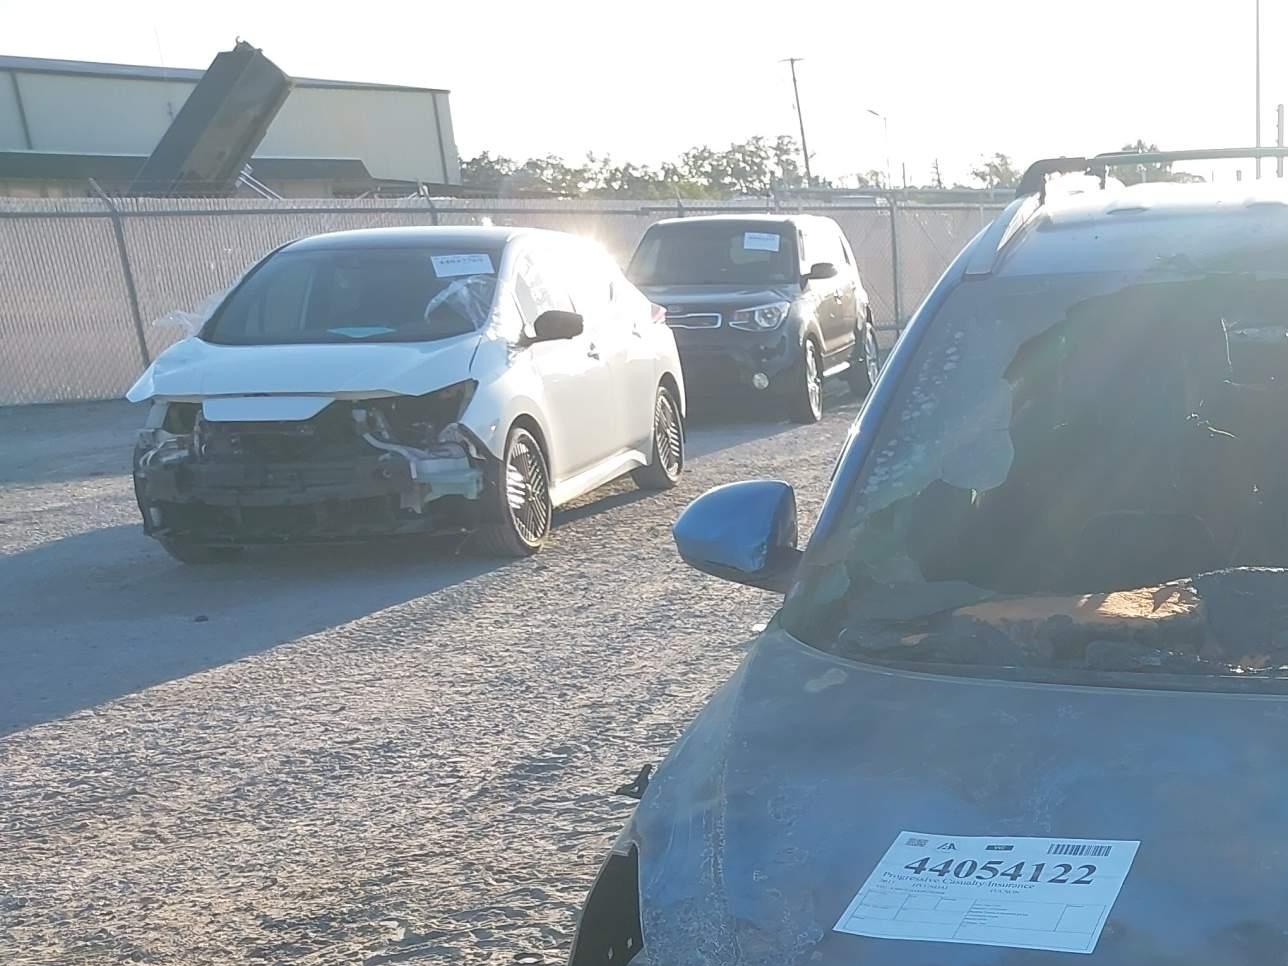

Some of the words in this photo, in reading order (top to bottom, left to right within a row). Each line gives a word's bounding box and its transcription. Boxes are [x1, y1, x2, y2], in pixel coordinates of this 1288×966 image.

[882, 871, 941, 883] Progressive
[942, 878, 984, 888] Casualty
[987, 881, 1036, 889] Insurance
[904, 856, 1097, 885] 44054122
